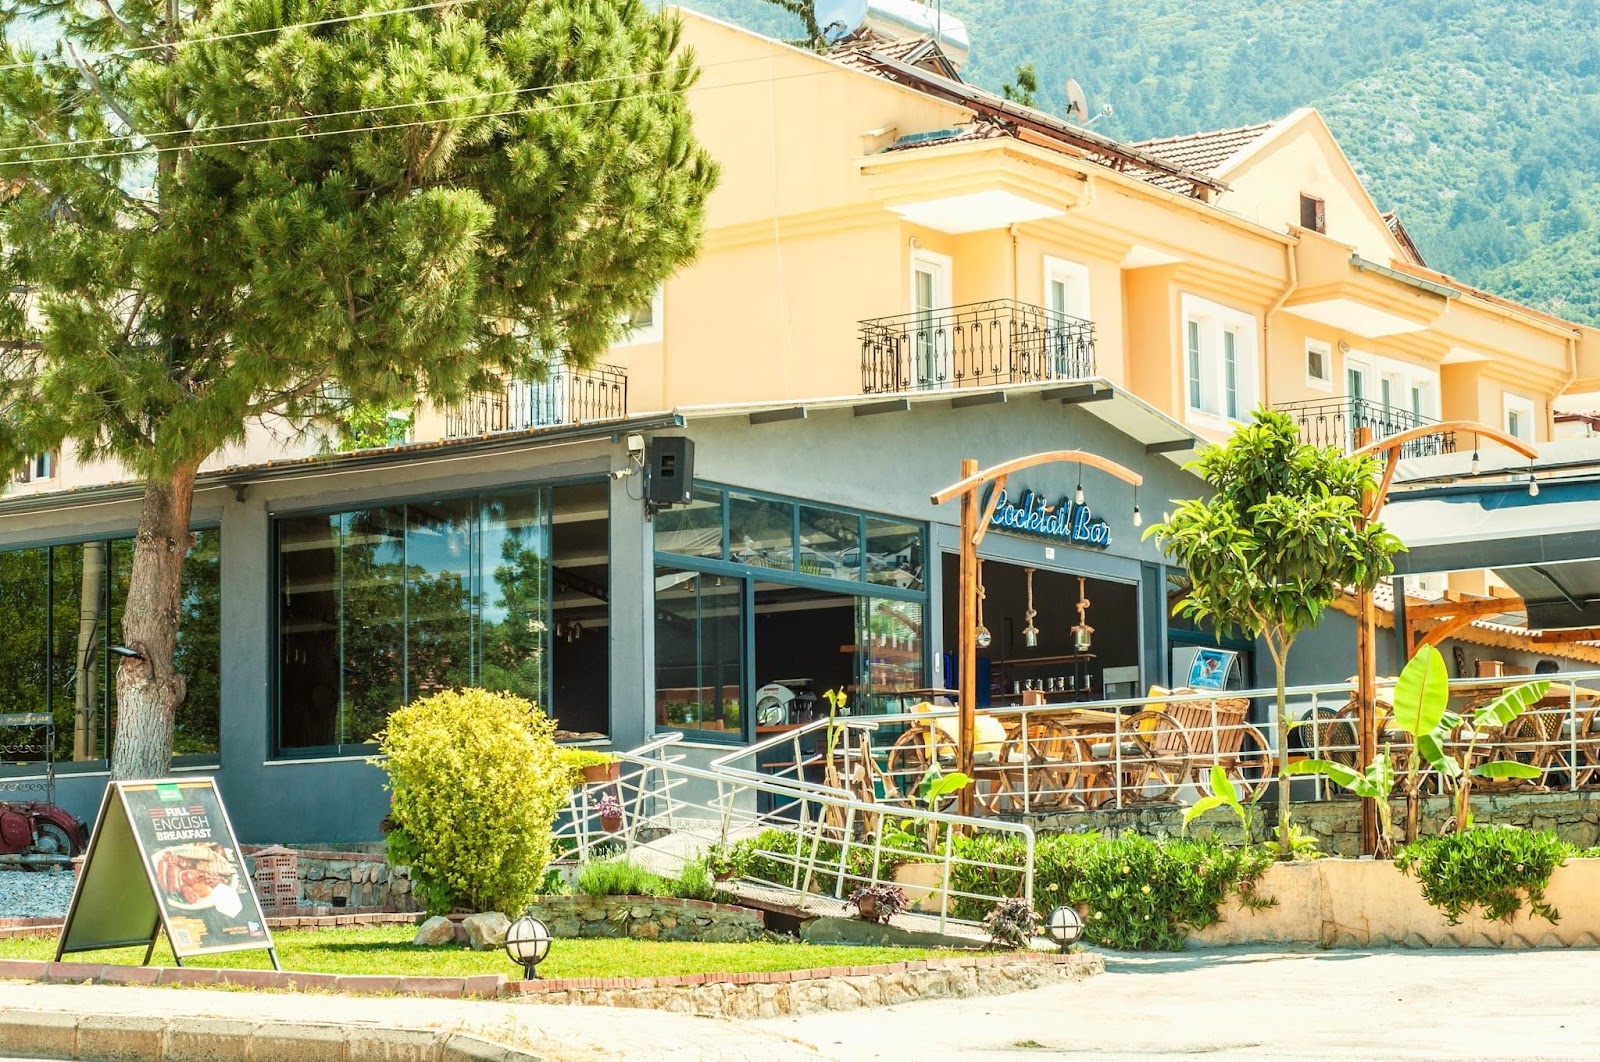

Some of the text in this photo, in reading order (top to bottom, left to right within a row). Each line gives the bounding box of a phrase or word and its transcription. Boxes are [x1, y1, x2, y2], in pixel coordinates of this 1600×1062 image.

[983, 484, 1113, 546] Cocktail Bar
[164, 807, 190, 817] FULL
[152, 815, 210, 831] ENGLISH
[155, 829, 212, 841] BREAKFAST
